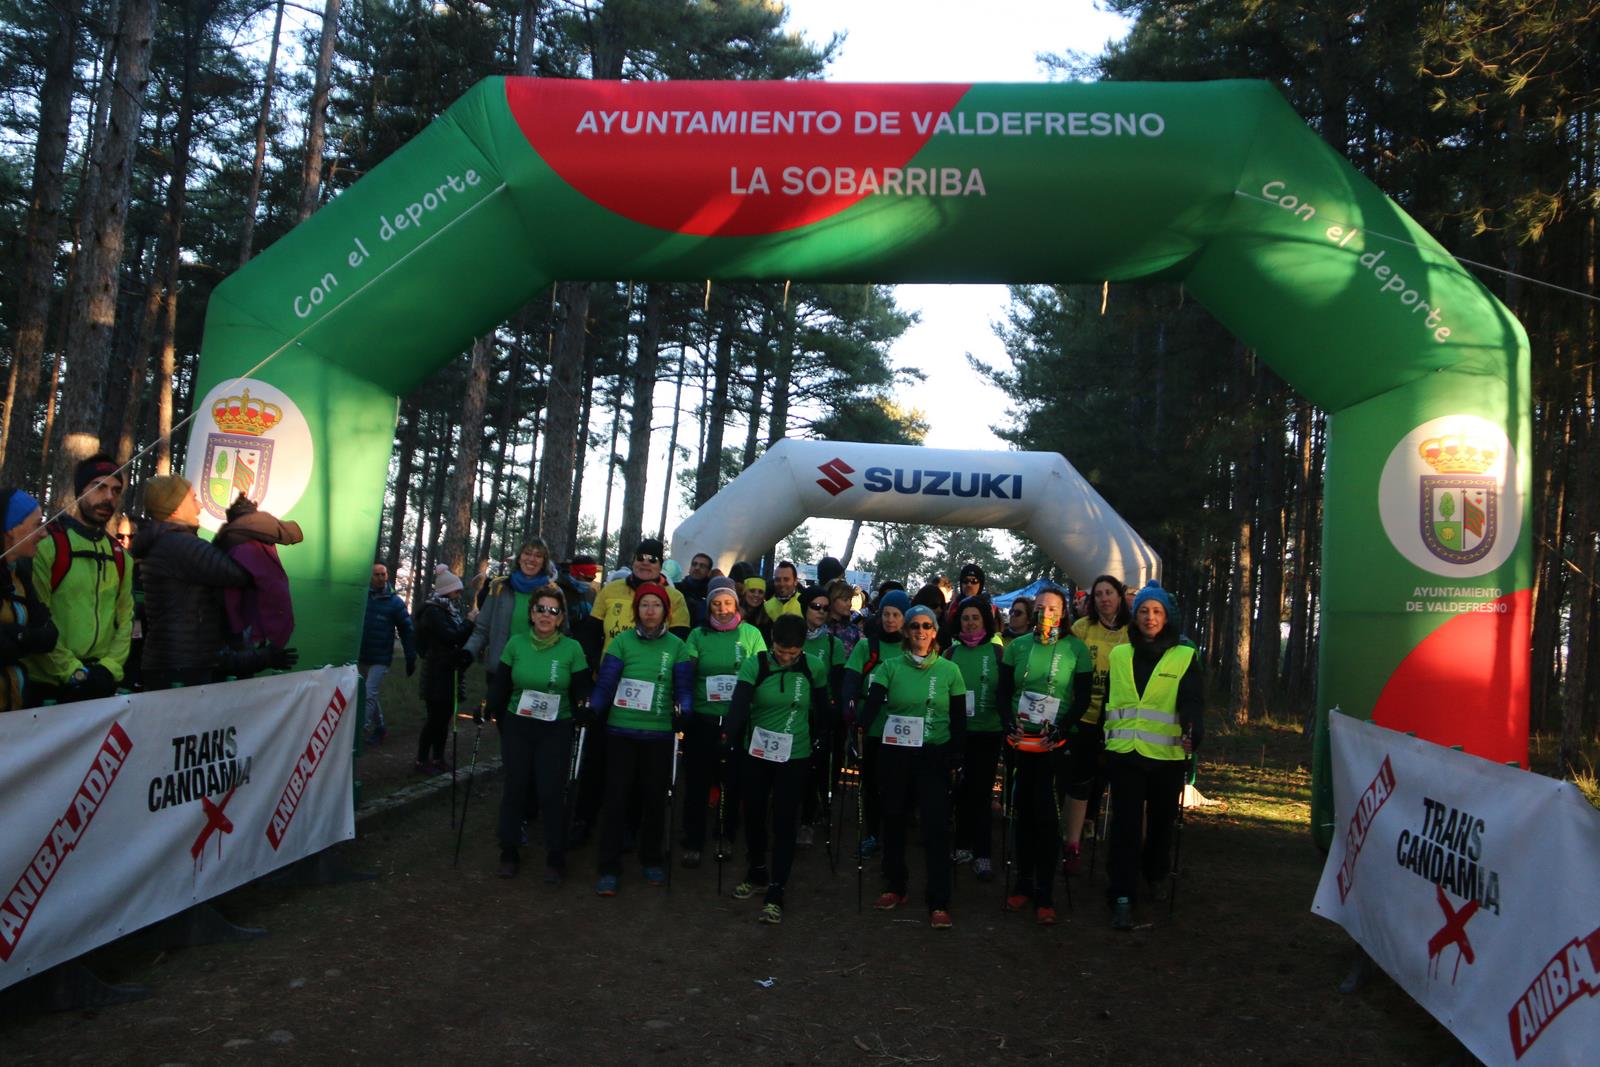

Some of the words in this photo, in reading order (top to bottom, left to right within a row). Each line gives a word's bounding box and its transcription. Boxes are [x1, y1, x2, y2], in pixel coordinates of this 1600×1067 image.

[576, 110, 842, 135] AYUNTAMIENTO
[854, 110, 901, 135] DE
[911, 111, 1166, 137] VALDEFRESNO
[730, 166, 770, 196] LA
[781, 166, 987, 196] SOBARRIBA
[294, 272, 338, 318] Con
[348, 237, 370, 268] el
[379, 169, 480, 241] deporte
[1262, 181, 1316, 222] Con
[1326, 225, 1358, 248] el
[1359, 250, 1451, 343] deporte
[863, 466, 1023, 500] SUZUKI
[1413, 586, 1502, 598] AYUNTAMIENTO
[1406, 601, 1423, 612] DE
[1426, 601, 1508, 613] VALDEFRESNO
[530, 700, 548, 711] 58
[625, 687, 641, 698] 67
[1028, 701, 1046, 714] 53
[894, 725, 911, 735] 66
[172, 726, 238, 771] TRANS
[763, 739, 779, 750] 13
[148, 756, 252, 812] CANDAMIA
[1423, 797, 1485, 862] TRANS
[1397, 829, 1500, 917] CANDAMIA
